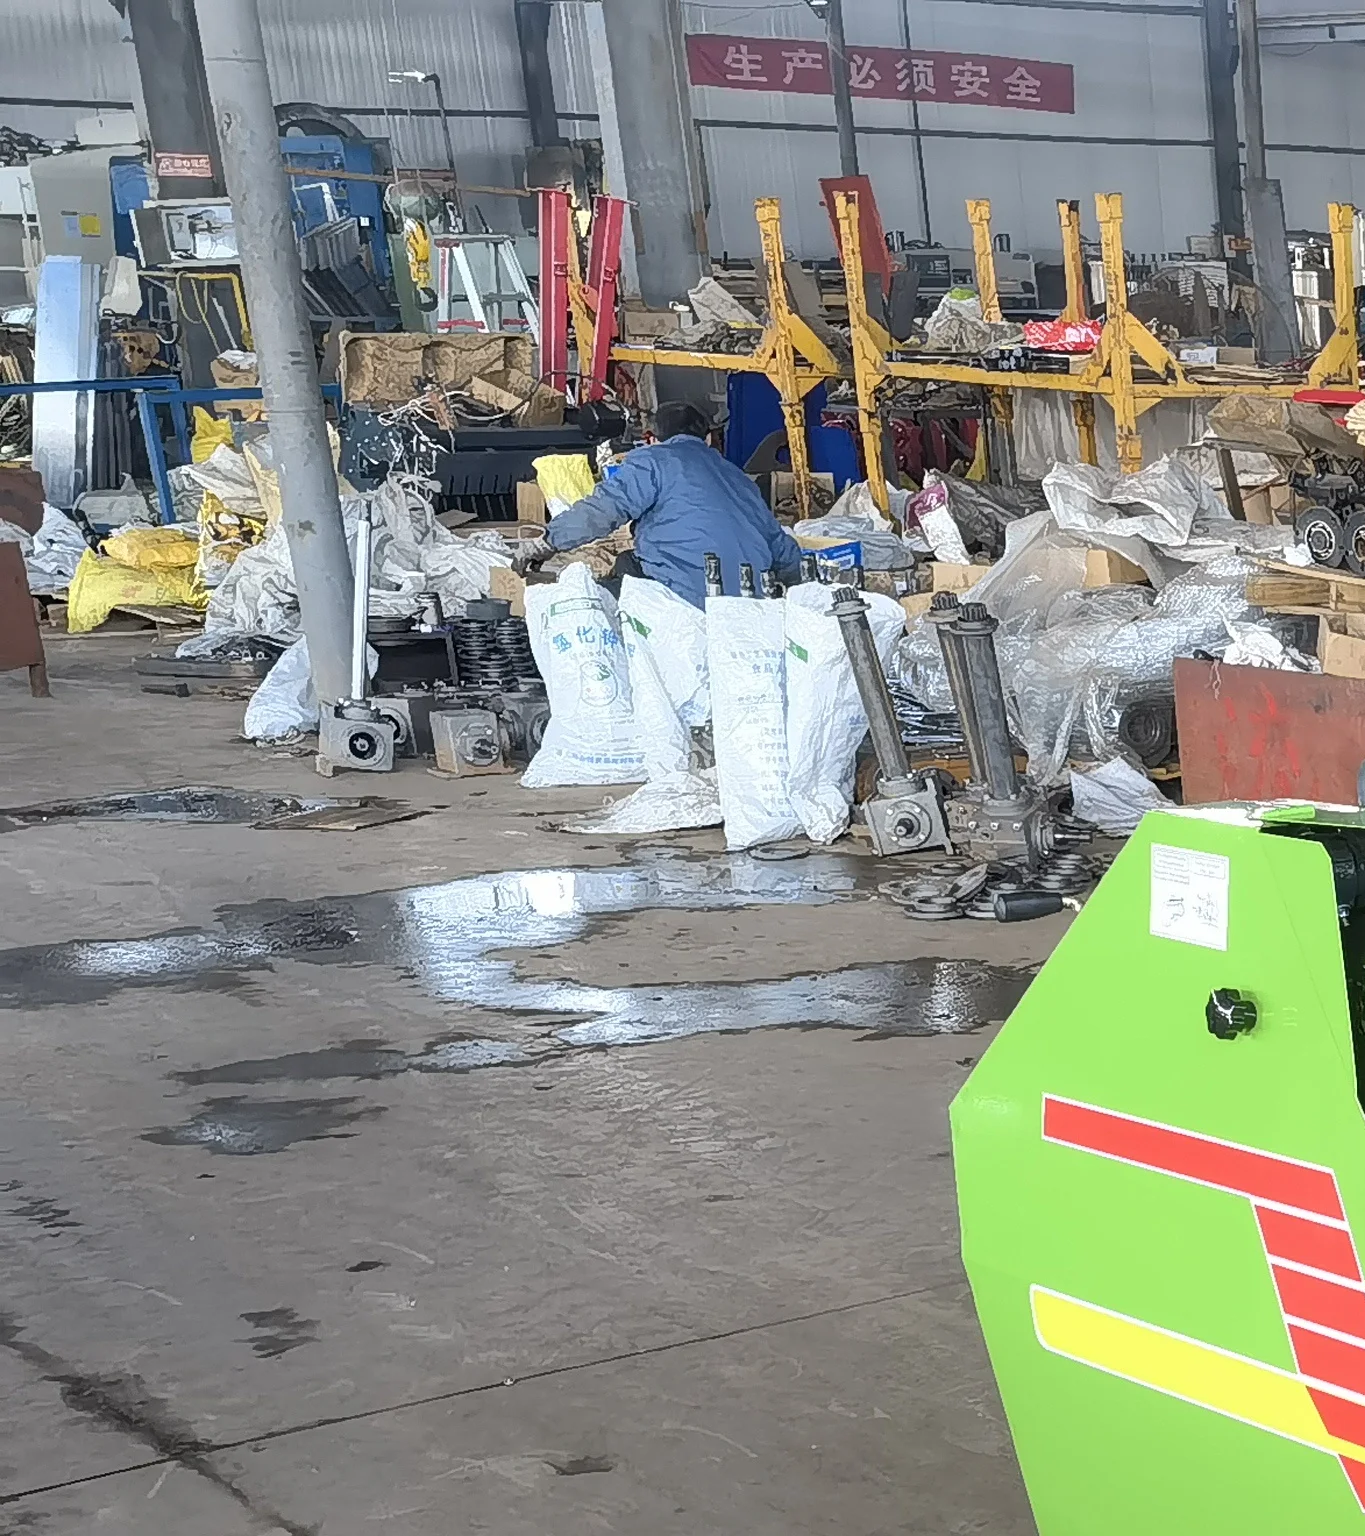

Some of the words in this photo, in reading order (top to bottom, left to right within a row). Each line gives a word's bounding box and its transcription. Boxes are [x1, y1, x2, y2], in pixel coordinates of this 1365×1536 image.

[723, 43, 1041, 103] 生产必须安全
